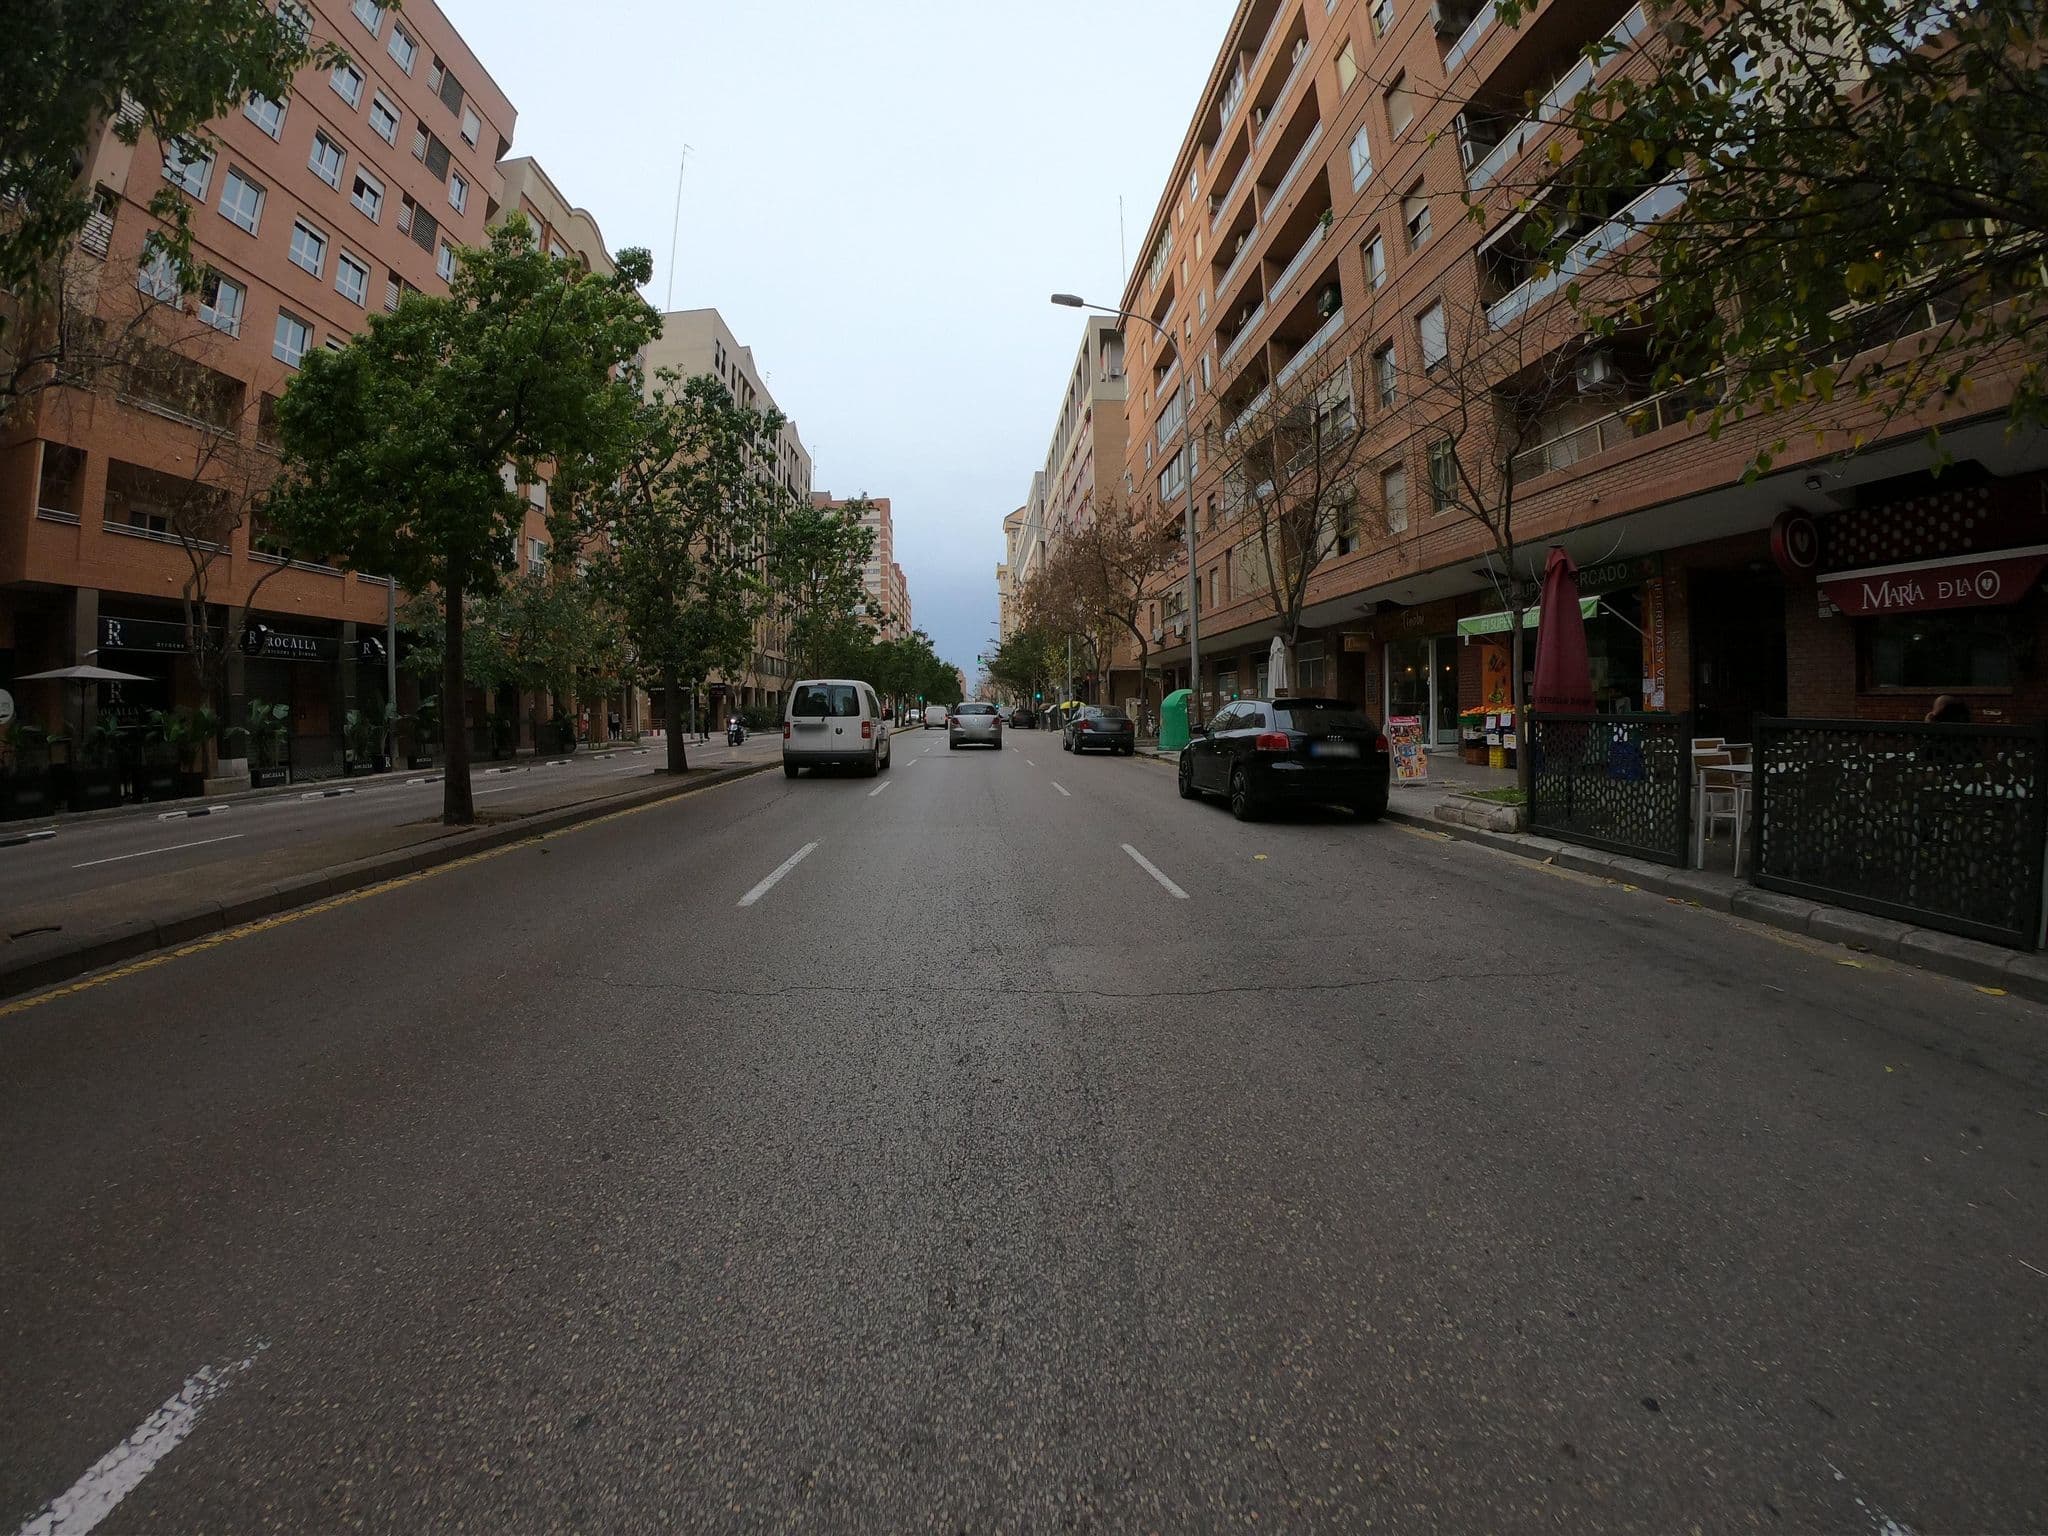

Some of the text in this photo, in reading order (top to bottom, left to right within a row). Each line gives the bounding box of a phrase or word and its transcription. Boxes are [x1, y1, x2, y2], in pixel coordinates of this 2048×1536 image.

[106, 619, 124, 646] R
[267, 636, 317, 652] ROCALLA
[362, 642, 372, 655] R
